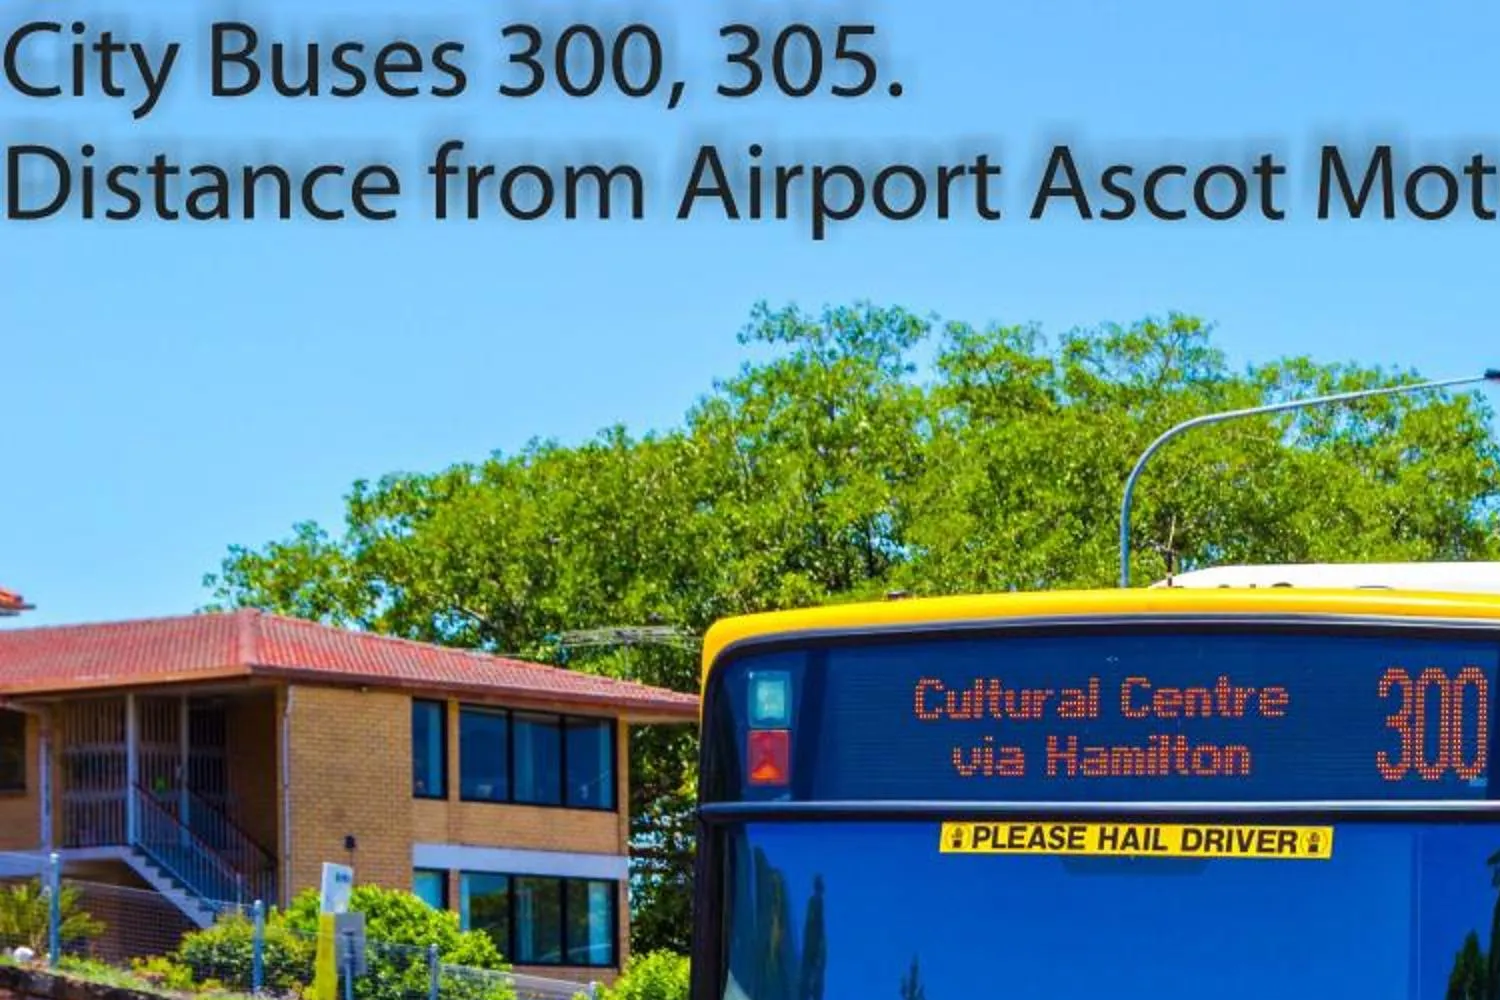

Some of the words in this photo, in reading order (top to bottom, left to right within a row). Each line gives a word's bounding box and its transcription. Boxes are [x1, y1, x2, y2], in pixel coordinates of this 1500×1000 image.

[912, 677, 1099, 720] Cultural
[1119, 675, 1290, 718] Centre
[1376, 666, 1489, 782] 300
[951, 736, 1026, 777] via
[1045, 734, 1251, 776] Hamilton
[971, 826, 1087, 850] PLEASE
[1097, 828, 1170, 852] HAIL
[1180, 829, 1299, 855] DRIVER
